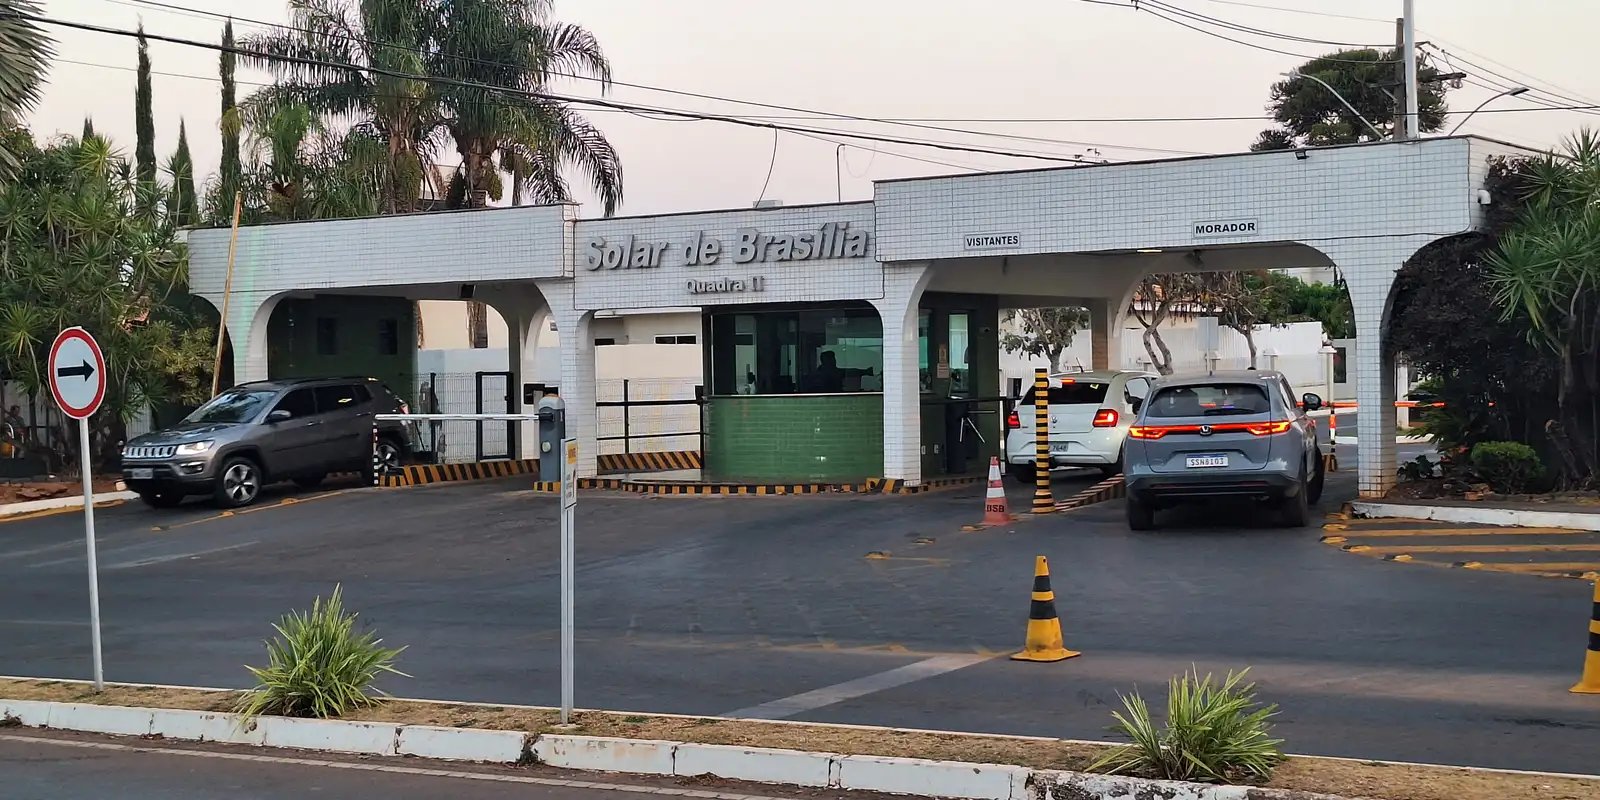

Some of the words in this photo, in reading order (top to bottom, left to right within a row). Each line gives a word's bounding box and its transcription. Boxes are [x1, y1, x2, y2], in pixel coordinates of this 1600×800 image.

[1195, 222, 1255, 234] MORADOR
[584, 235, 669, 271] Solar
[680, 231, 721, 266] de
[733, 222, 868, 265] Brasília
[966, 235, 1018, 247] VISITANTES
[686, 277, 746, 295] Quadra
